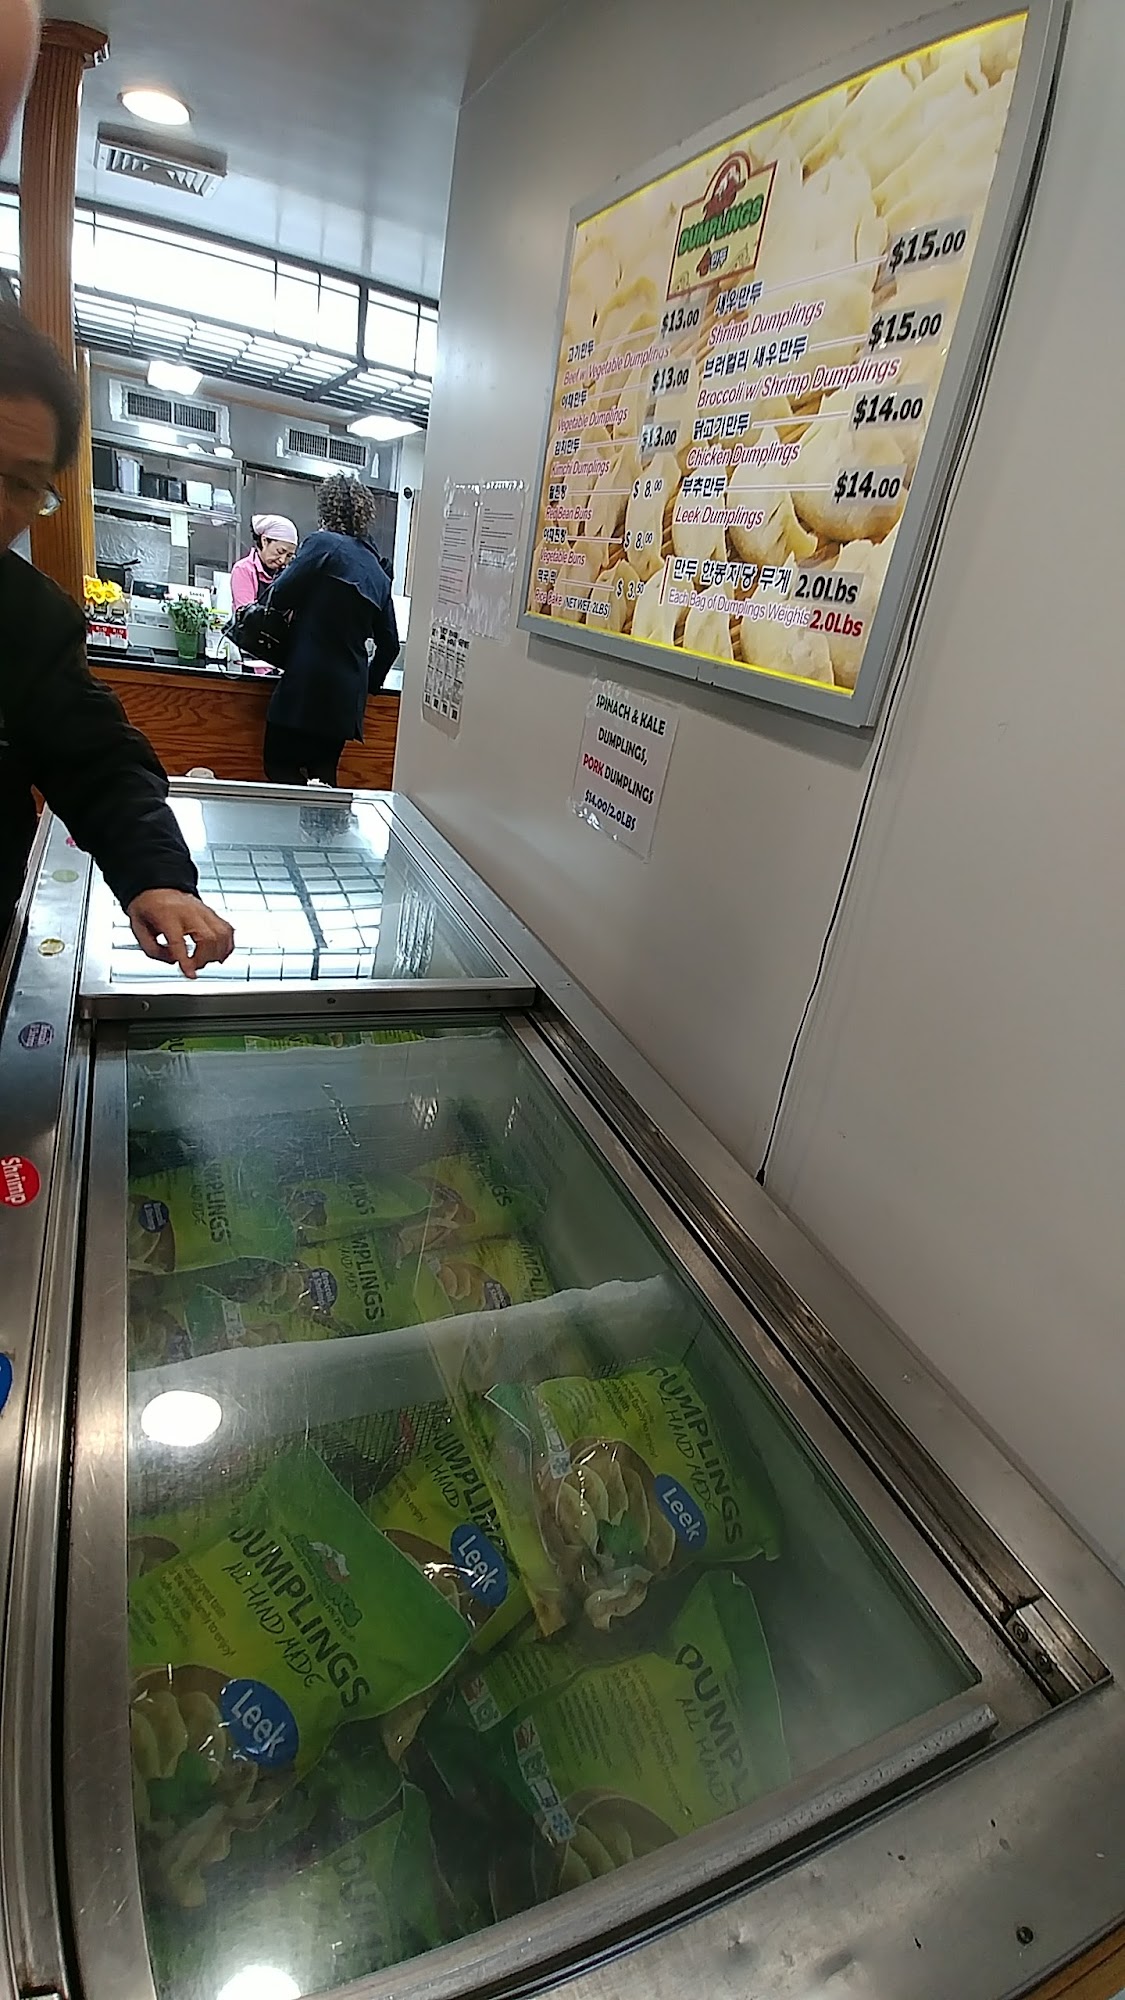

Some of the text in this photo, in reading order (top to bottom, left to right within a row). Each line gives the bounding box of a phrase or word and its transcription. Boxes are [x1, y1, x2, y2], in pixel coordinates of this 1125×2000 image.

[678, 193, 764, 257] DUMPLINGS
[888, 229, 966, 274] $15.00
[715, 282, 763, 315] 새우만두
[661, 308, 700, 338] $13.00
[709, 300, 824, 346] Shrimp Dumplings
[868, 311, 942, 351] $15.00
[563, 370, 580, 385] Beef
[588, 356, 623, 379] Vegetable
[624, 346, 670, 368] Dumplings
[752, 335, 807, 369] 새우만두
[652, 366, 689, 395] $13.00
[697, 357, 900, 407] Broccoli w/ Shrimp Dumplings
[557, 407, 628, 434] Vegetable Dumplings
[853, 395, 923, 430] $14.00
[640, 426, 677, 452] $13.00
[687, 443, 800, 468] Chicken Dumplings
[552, 459, 610, 477] Kimchi Dumplings
[682, 477, 726, 497] 부추만두
[834, 471, 900, 503] $14.00
[546, 506, 592, 521] Red Bean Buns
[675, 505, 764, 528] Leek Dumplings
[540, 548, 585, 566] Vegetable Buns
[547, 591, 562, 605] Cake
[673, 559, 698, 580] 만두
[760, 567, 793, 594] 무게
[795, 574, 858, 604] 2.0Lbs
[669, 588, 863, 637] Each Bag of Dumplings Weights 2.0Lbs
[595, 694, 666, 736] SPINACH & KALE
[598, 727, 648, 766] DUMPLINGS,
[582, 753, 654, 805] PORK DUMPLINGS
[585, 789, 637, 831] $14.00/2.0LBS
[1, 1157, 27, 1204] Shrimp
[666, 1410, 694, 1459] HAND
[430, 1464, 460, 1508] HAND
[662, 1487, 700, 1542] Leek
[457, 1535, 499, 1593] Leek
[243, 1583, 286, 1634] HAND
[274, 1637, 326, 1689] MADE
[231, 1688, 286, 1759] Leek
